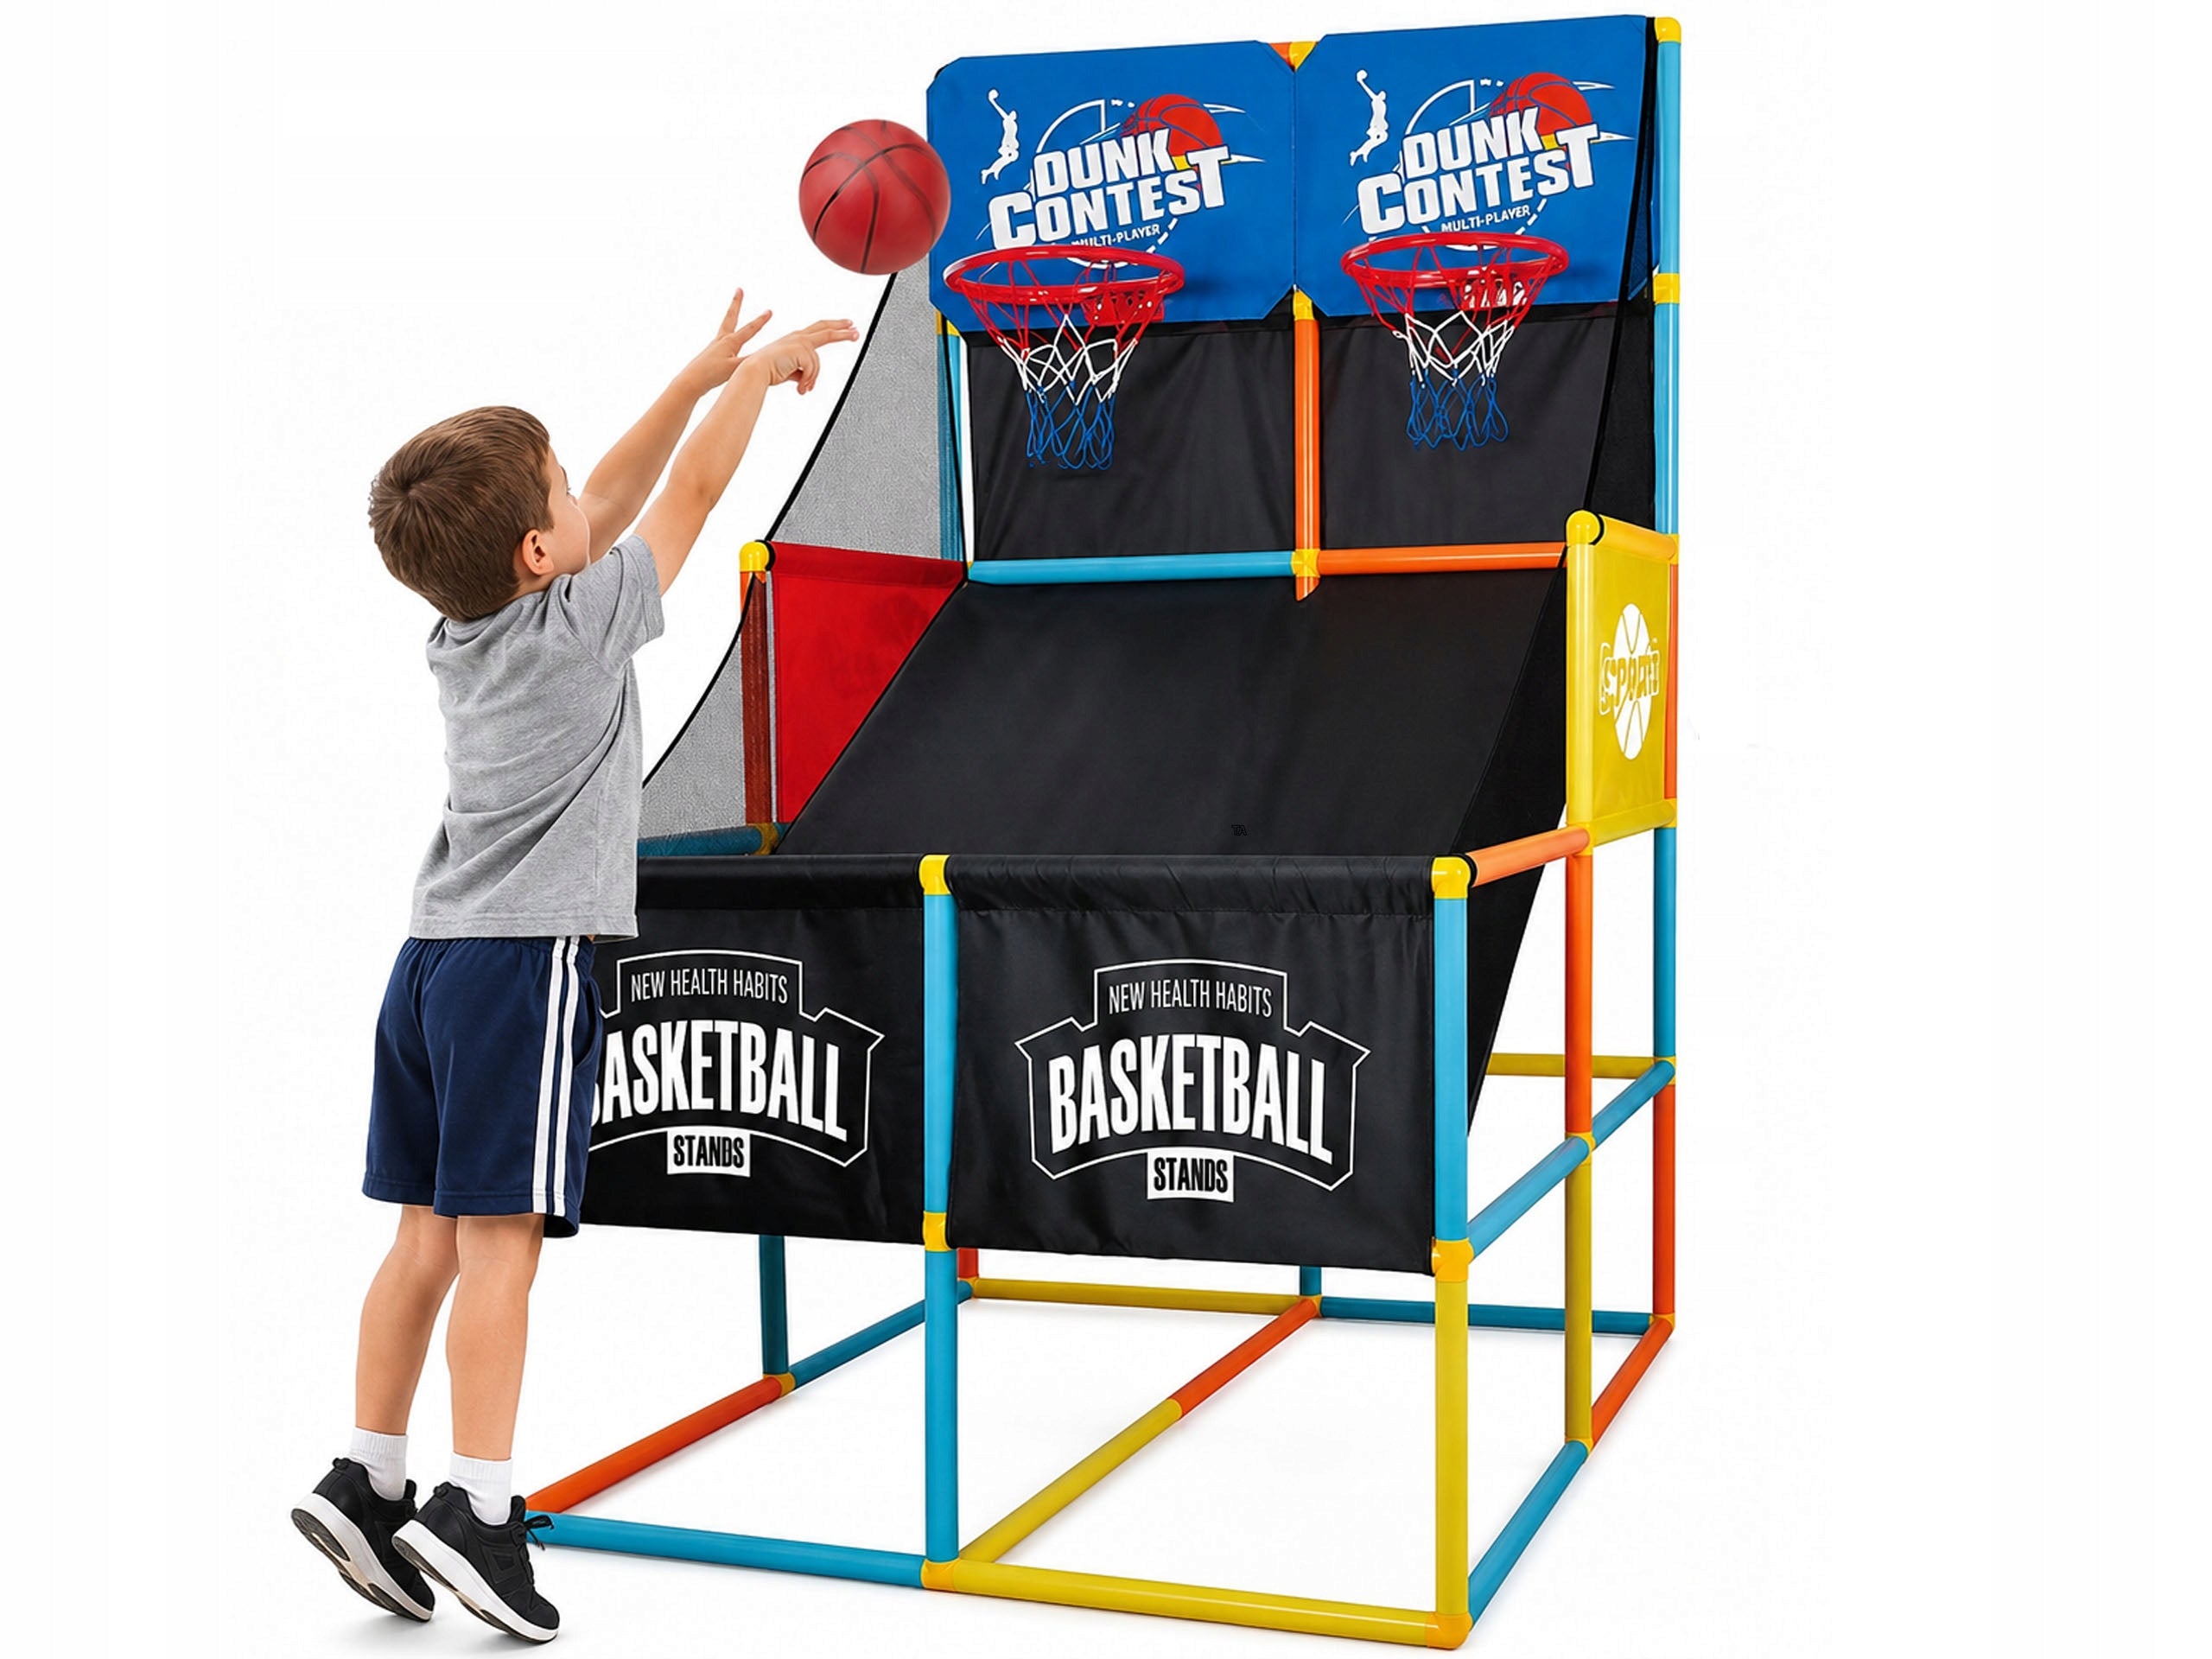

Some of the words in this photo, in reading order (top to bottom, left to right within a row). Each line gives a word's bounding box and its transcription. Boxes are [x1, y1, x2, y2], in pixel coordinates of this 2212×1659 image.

[1033, 128, 1175, 198] DUNK
[1402, 106, 1543, 179] DUNK
[988, 146, 1230, 250] CONTEST
[1357, 124, 1599, 235] CONTEST
[1441, 205, 1530, 232] MULTI-PLAYER
[631, 971, 665, 1002] NEW
[671, 968, 728, 996] HEALTH
[733, 969, 788, 1004] HABITS
[1109, 982, 1145, 1015] NEW
[1151, 979, 1210, 1008] HEALTH
[1216, 981, 1272, 1018] HABITS
[591, 1020, 848, 1142] ASKETBALL
[1048, 1034, 1332, 1165] BASKETBALL
[1154, 1158, 1228, 1192] STANDS
